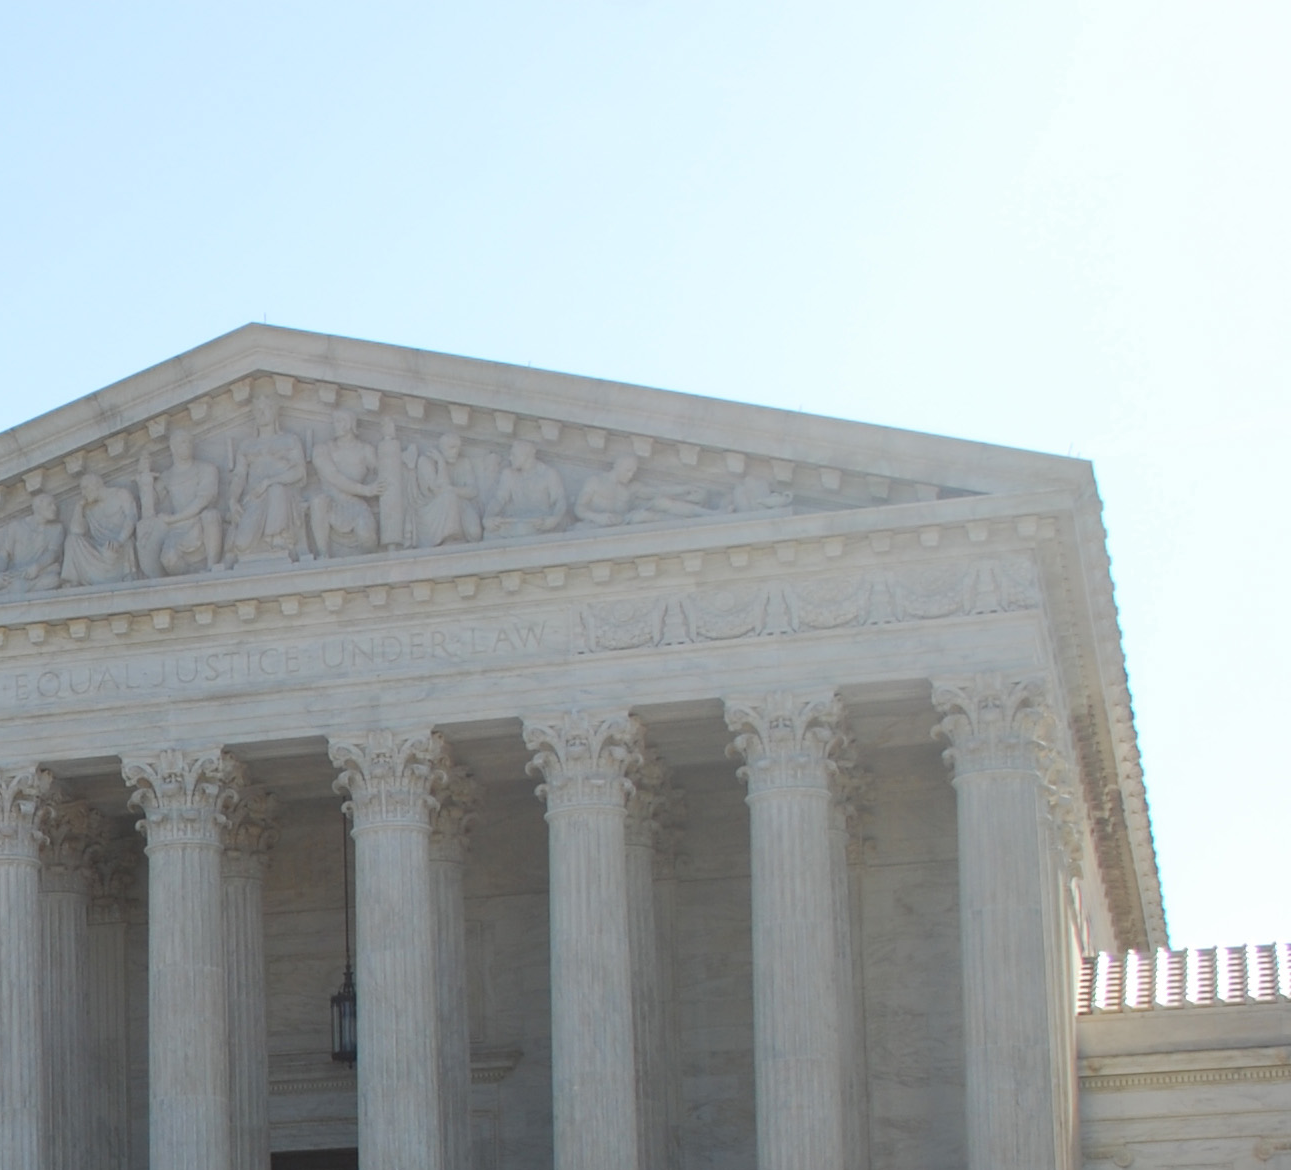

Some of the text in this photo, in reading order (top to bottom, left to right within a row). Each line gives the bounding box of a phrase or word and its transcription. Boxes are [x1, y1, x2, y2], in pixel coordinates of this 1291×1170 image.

[14, 620, 547, 700] EQUAL JUSTICE UNDER LAW
